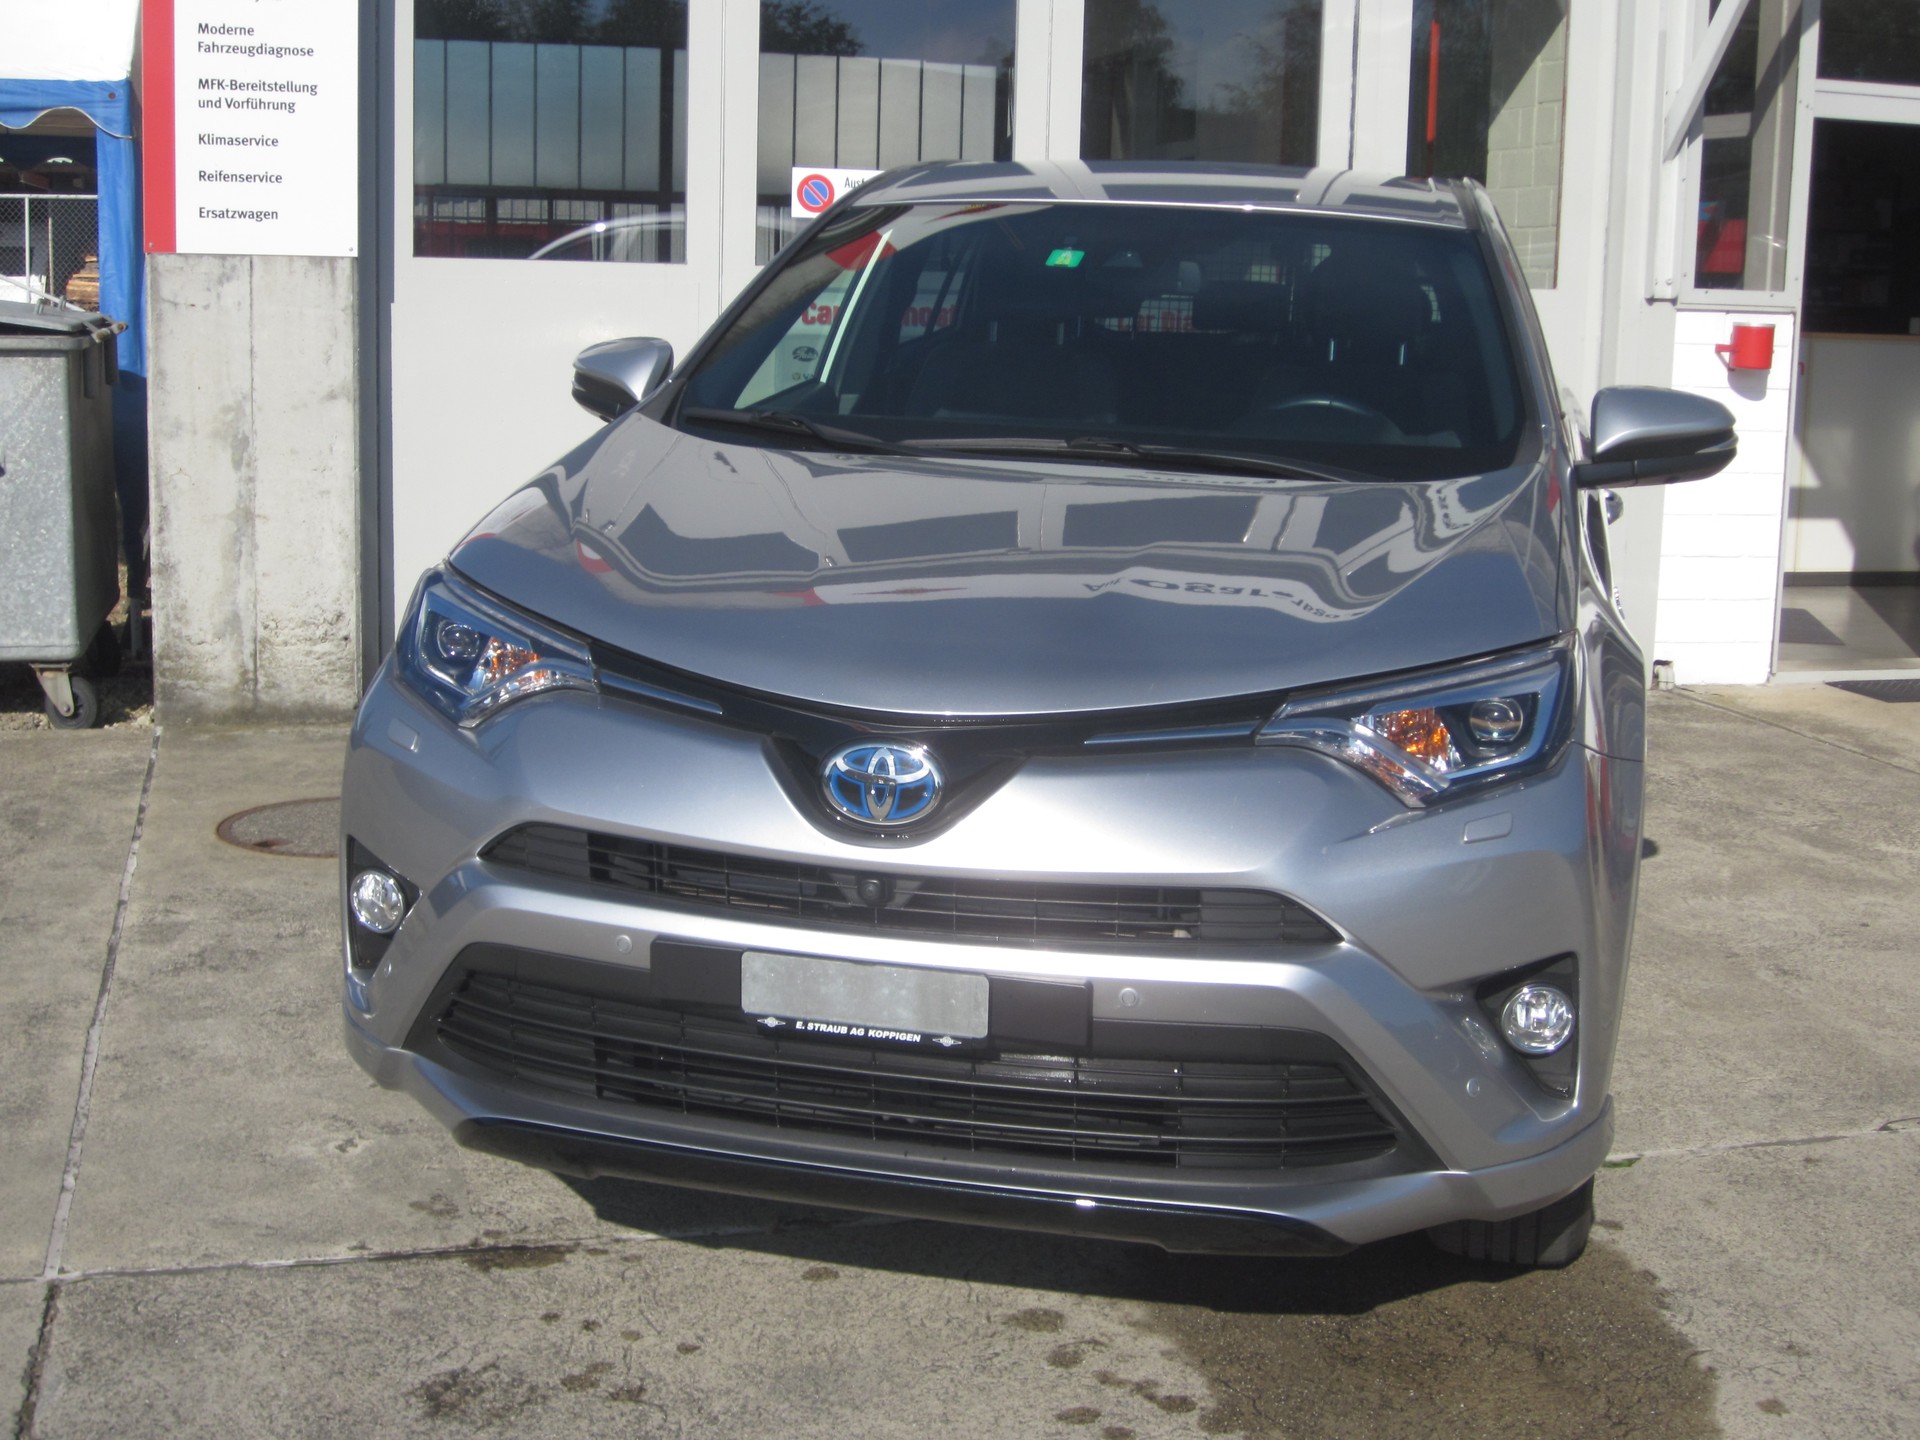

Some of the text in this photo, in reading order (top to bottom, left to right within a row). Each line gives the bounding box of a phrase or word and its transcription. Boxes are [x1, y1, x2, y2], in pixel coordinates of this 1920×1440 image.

[197, 23, 255, 36] Moderne
[197, 42, 314, 58] Fahrzeugdiagnose
[198, 78, 318, 96] MFK-Bereitstellung
[198, 97, 296, 114] und Vorführung
[198, 134, 279, 147] Klimaservice
[198, 170, 283, 183] Reifenservice
[199, 207, 279, 222] Ersatzwagen
[795, 1021, 922, 1043] E. STRAUB AG KOPPIGEN
